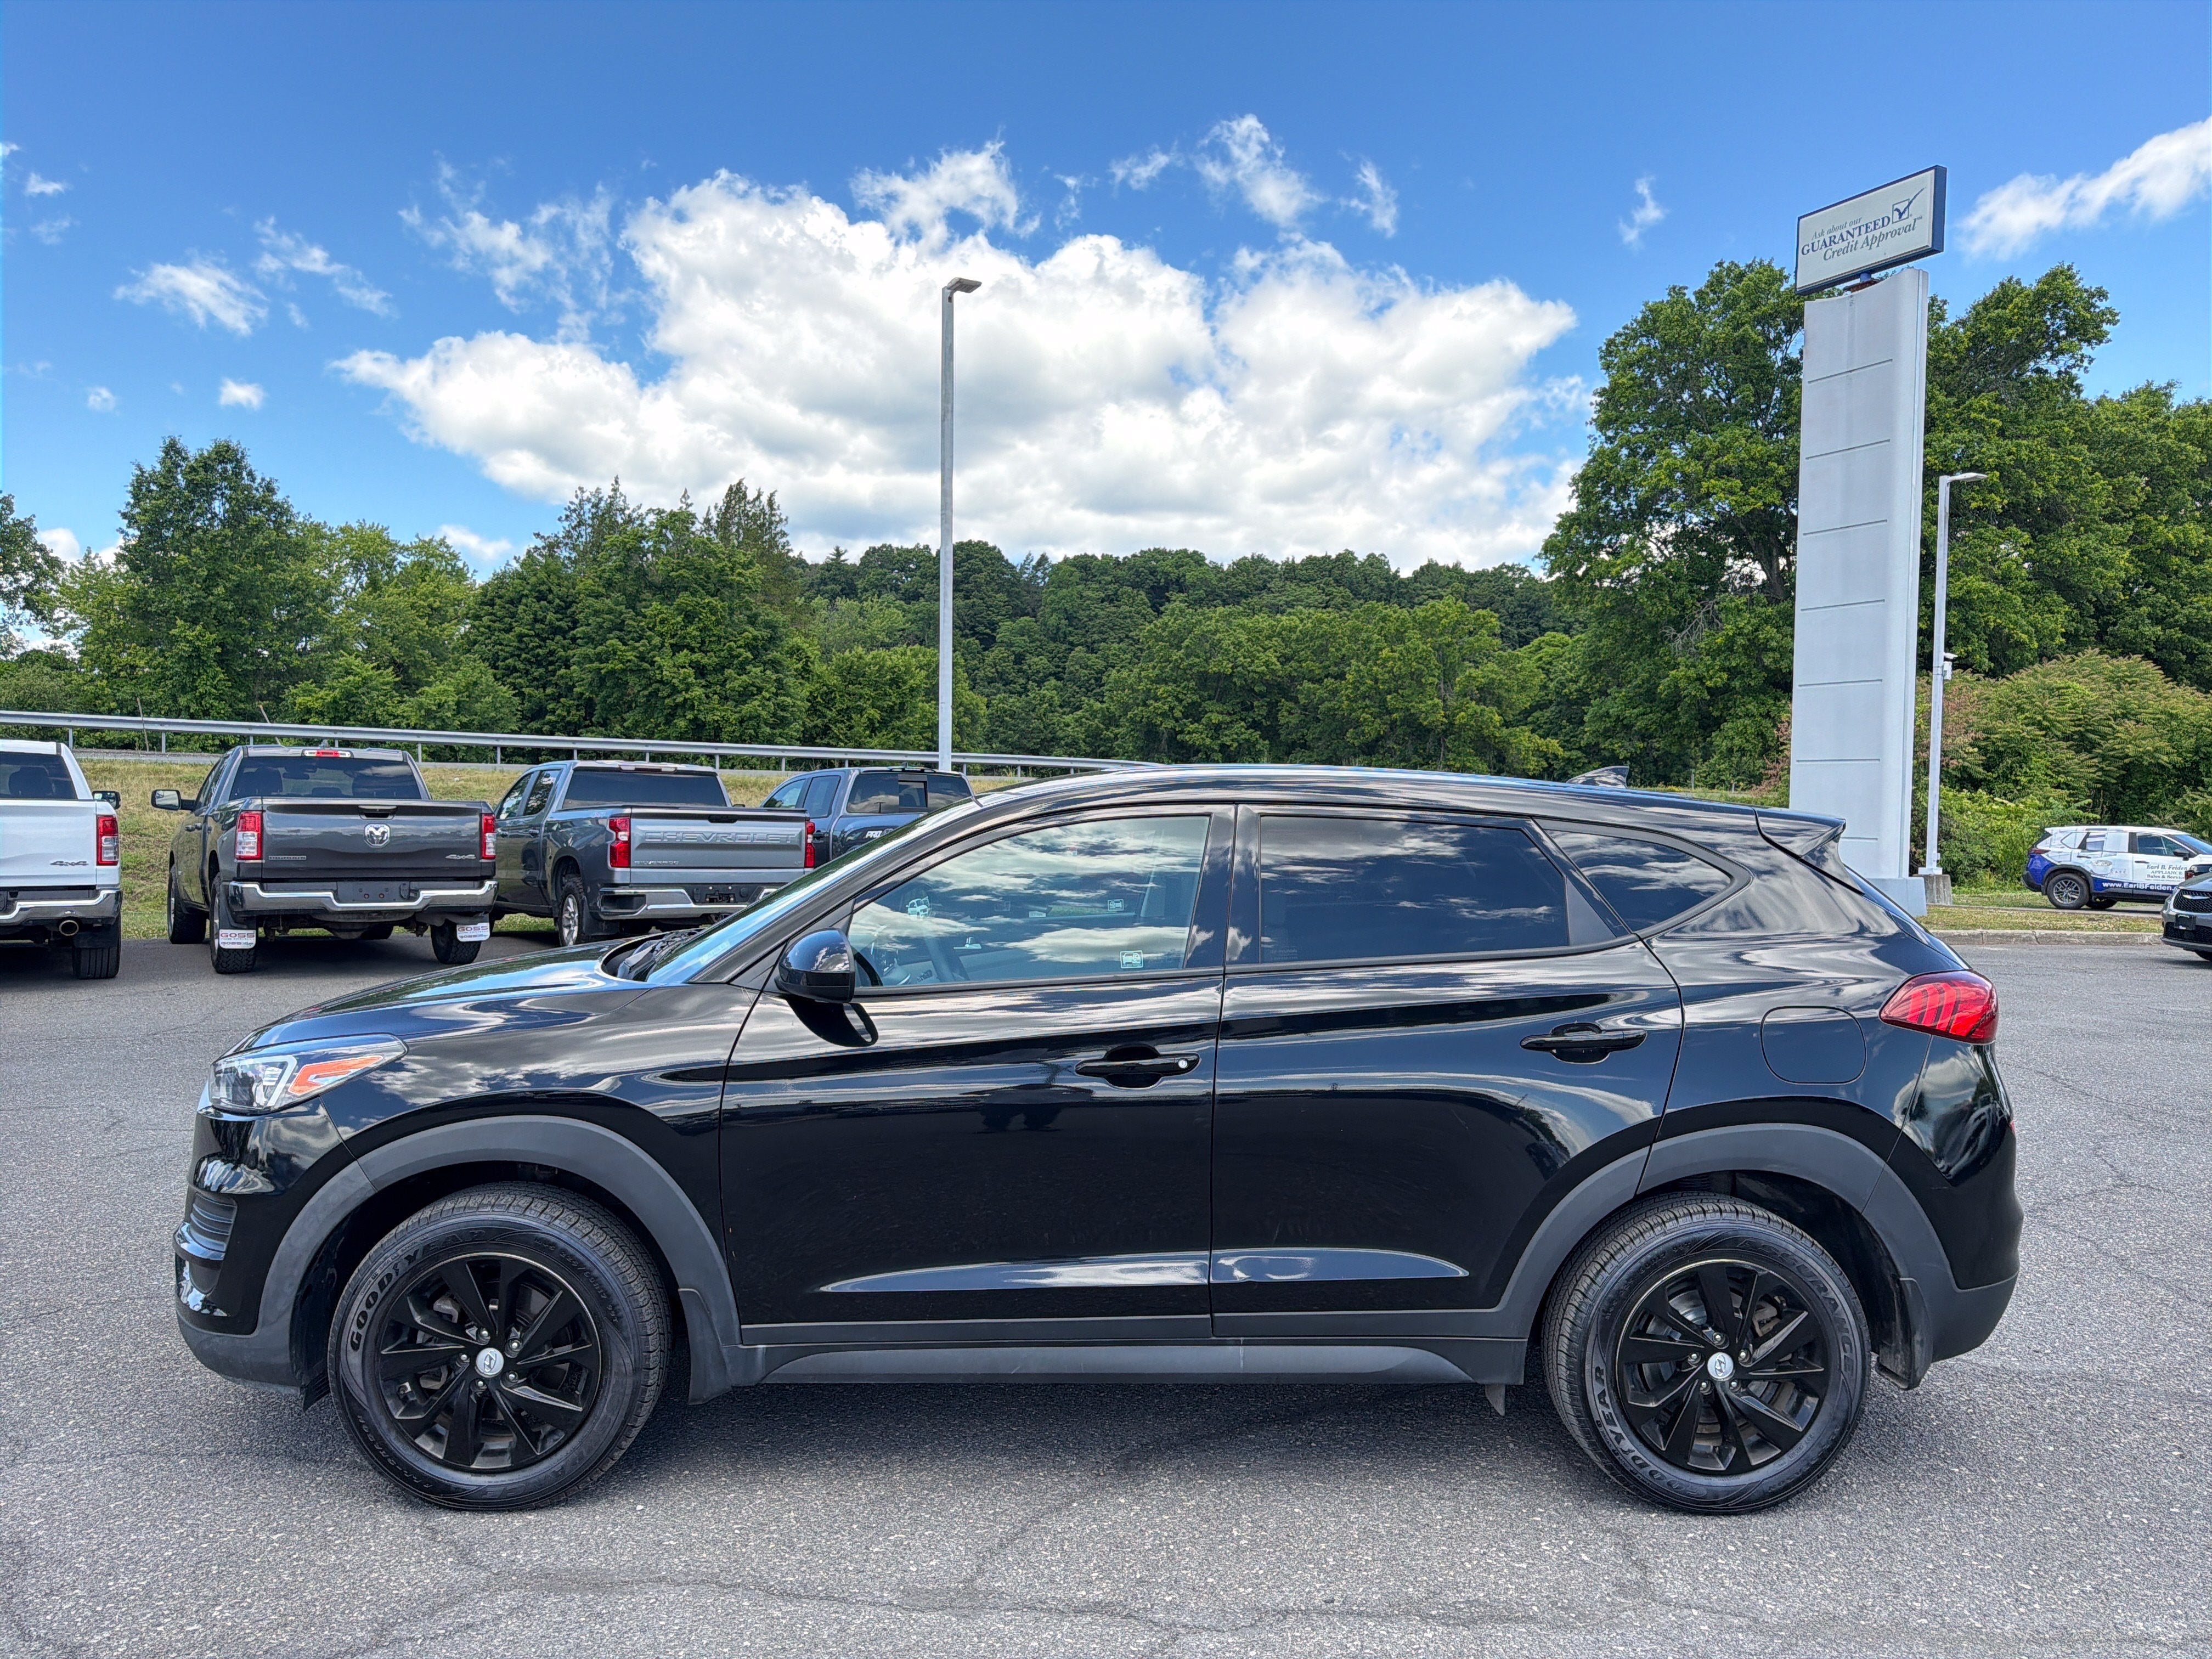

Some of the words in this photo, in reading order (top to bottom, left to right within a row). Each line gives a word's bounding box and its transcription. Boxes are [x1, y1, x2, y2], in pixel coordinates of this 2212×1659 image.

[1801, 215, 1891, 256] GUARANTEED
[1811, 229, 1825, 240] Ask
[1826, 221, 1847, 235] about
[1848, 217, 1863, 227] our
[1823, 239, 1859, 261] Credit
[645, 831, 796, 844] CHEVROLET
